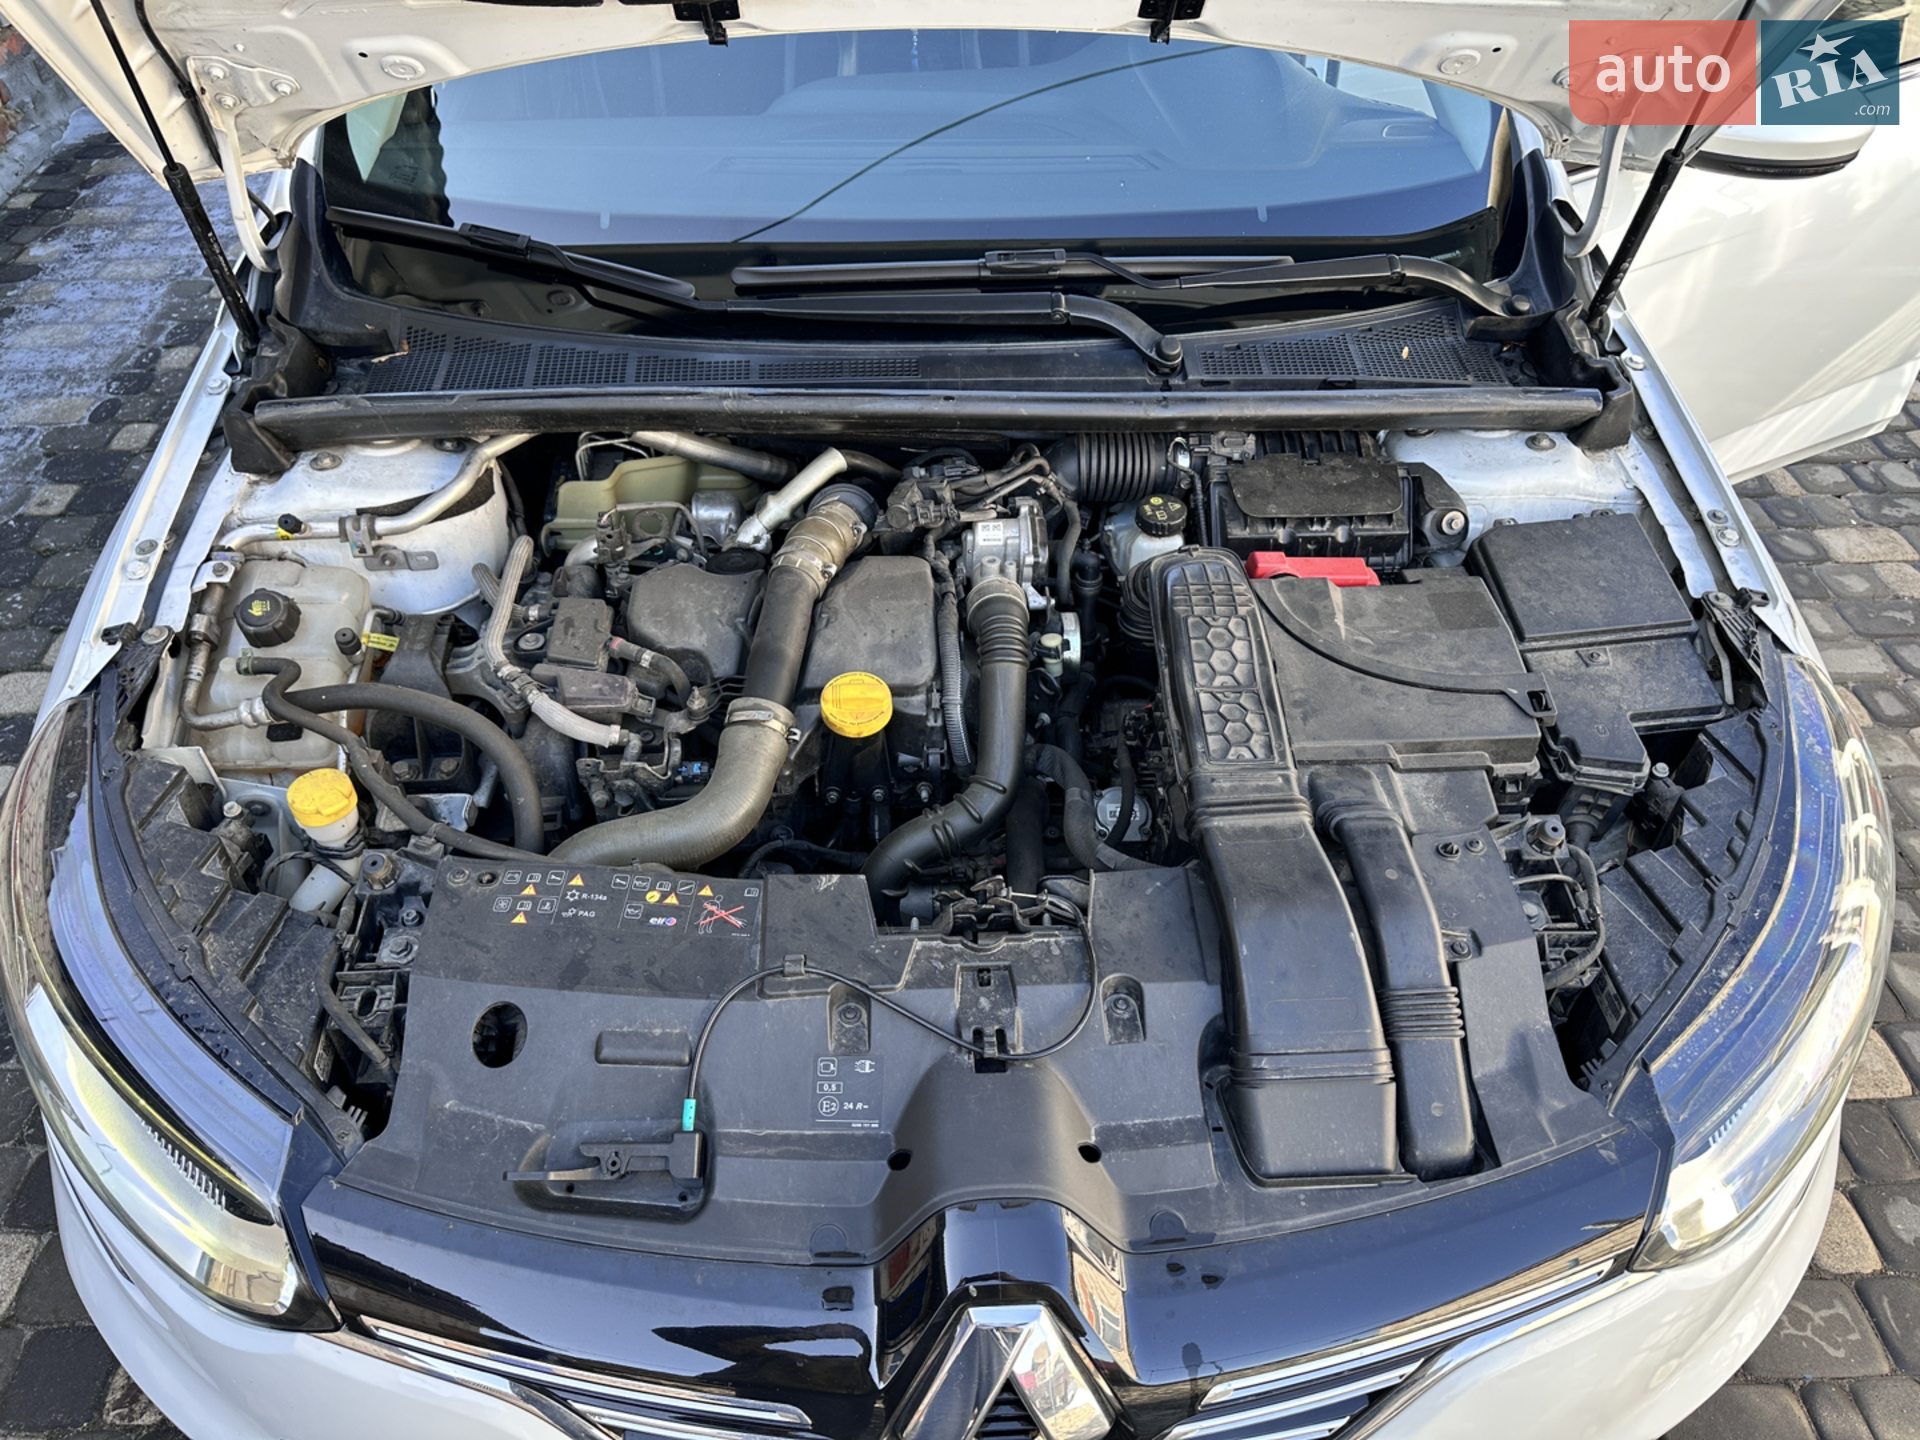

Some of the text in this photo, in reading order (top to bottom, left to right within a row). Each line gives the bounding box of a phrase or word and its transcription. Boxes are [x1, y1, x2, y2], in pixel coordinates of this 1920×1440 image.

[581, 893, 607, 901] R-134a
[649, 917, 667, 925] elf
[822, 1101, 837, 1112] E2
[843, 1102, 853, 1110] 24
